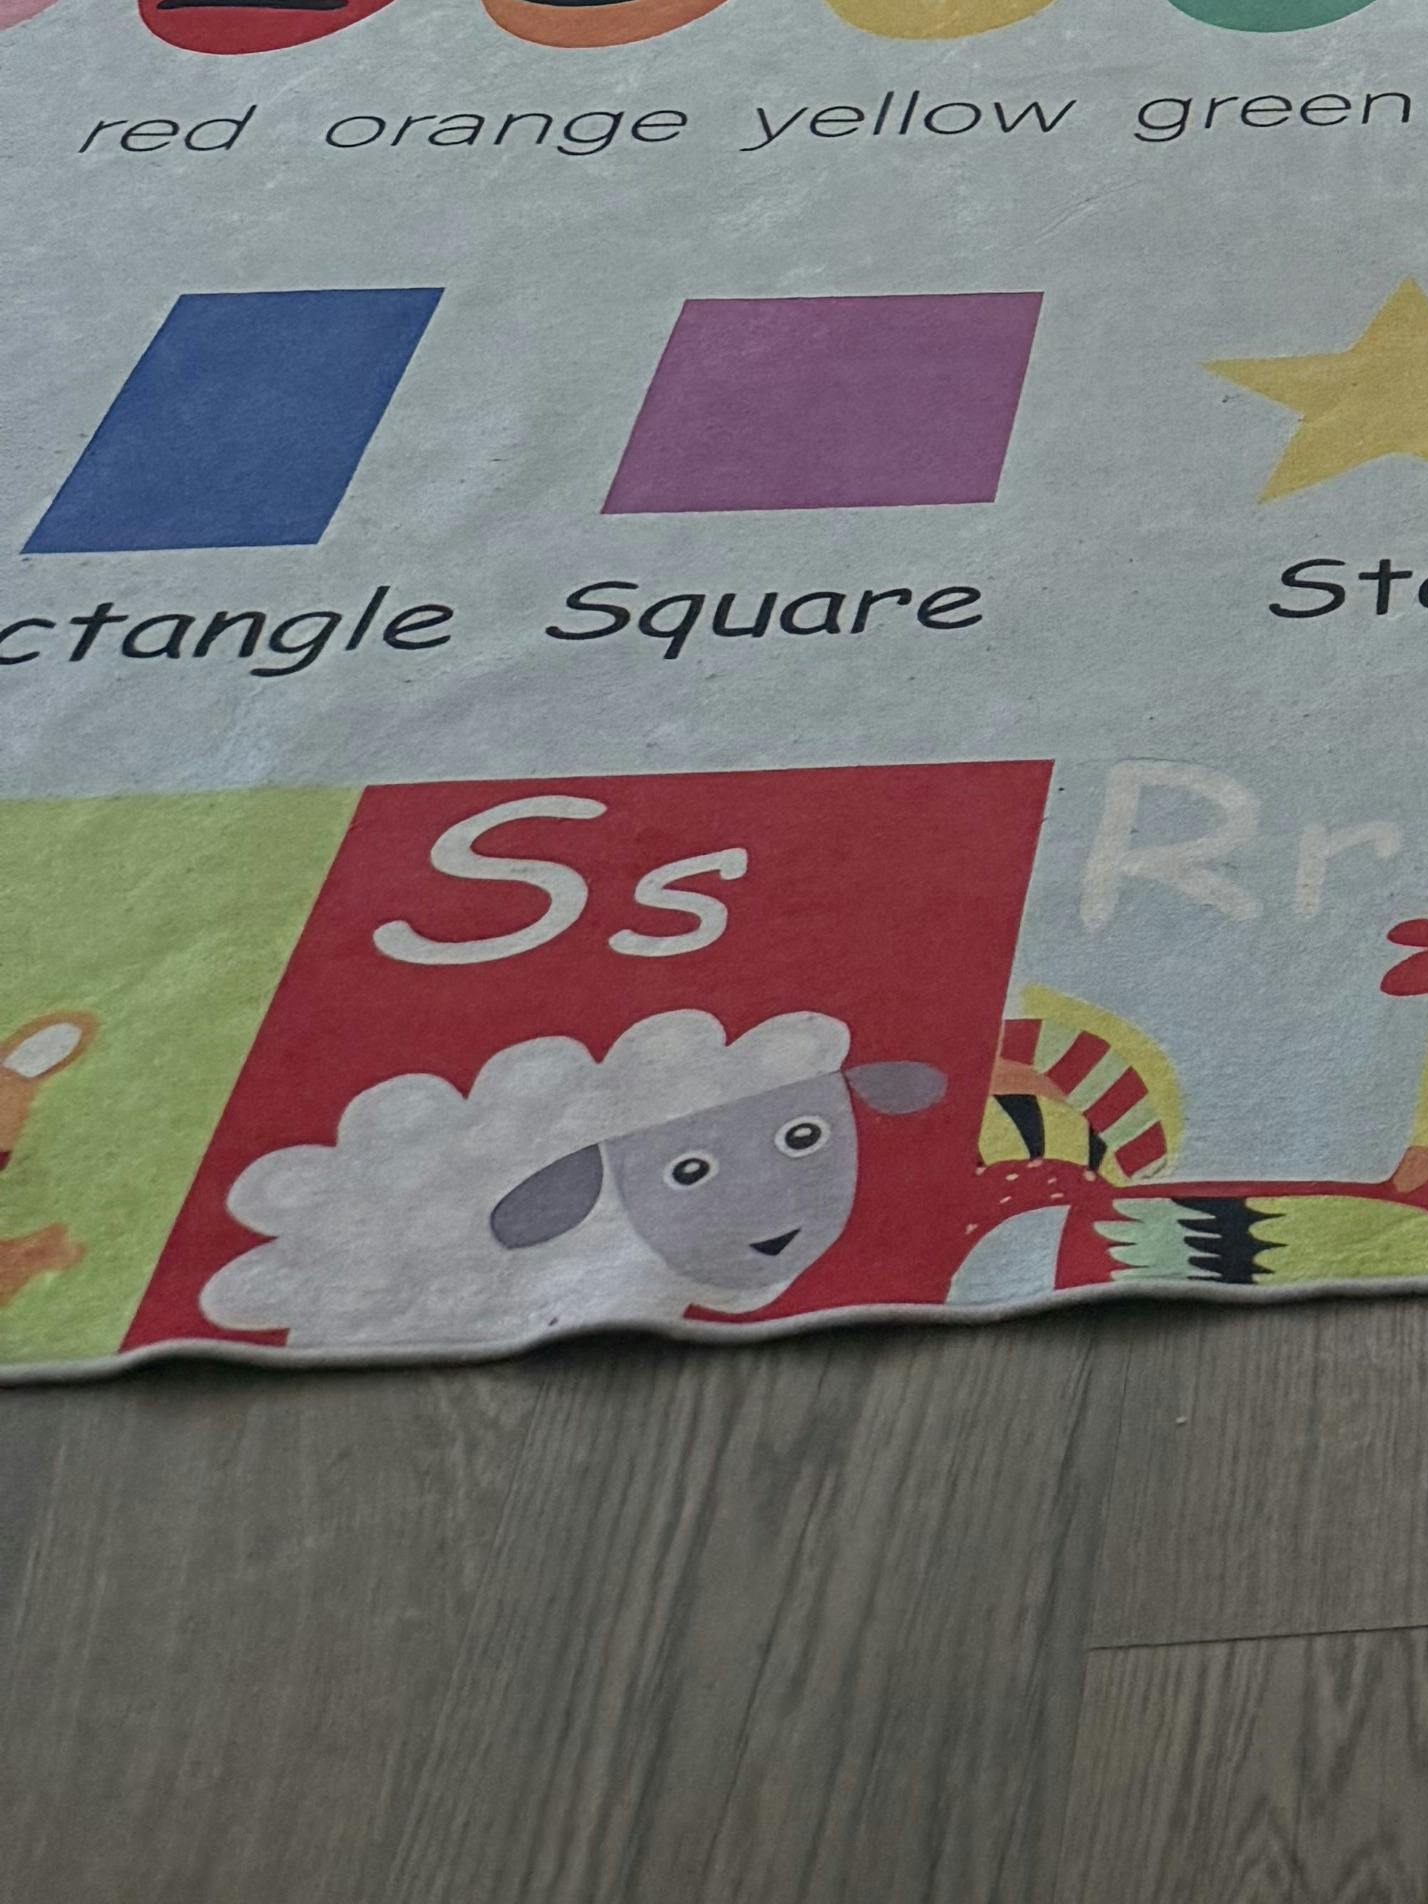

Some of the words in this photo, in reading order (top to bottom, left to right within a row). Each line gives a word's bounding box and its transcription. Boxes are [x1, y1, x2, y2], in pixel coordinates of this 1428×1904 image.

[76, 104, 258, 155] red
[321, 104, 689, 158] orange
[744, 91, 1078, 152] yellow
[1134, 87, 1412, 144] green
[543, 580, 983, 662] Square
[372, 794, 748, 967] Ss
[1080, 759, 1402, 932] Rr
